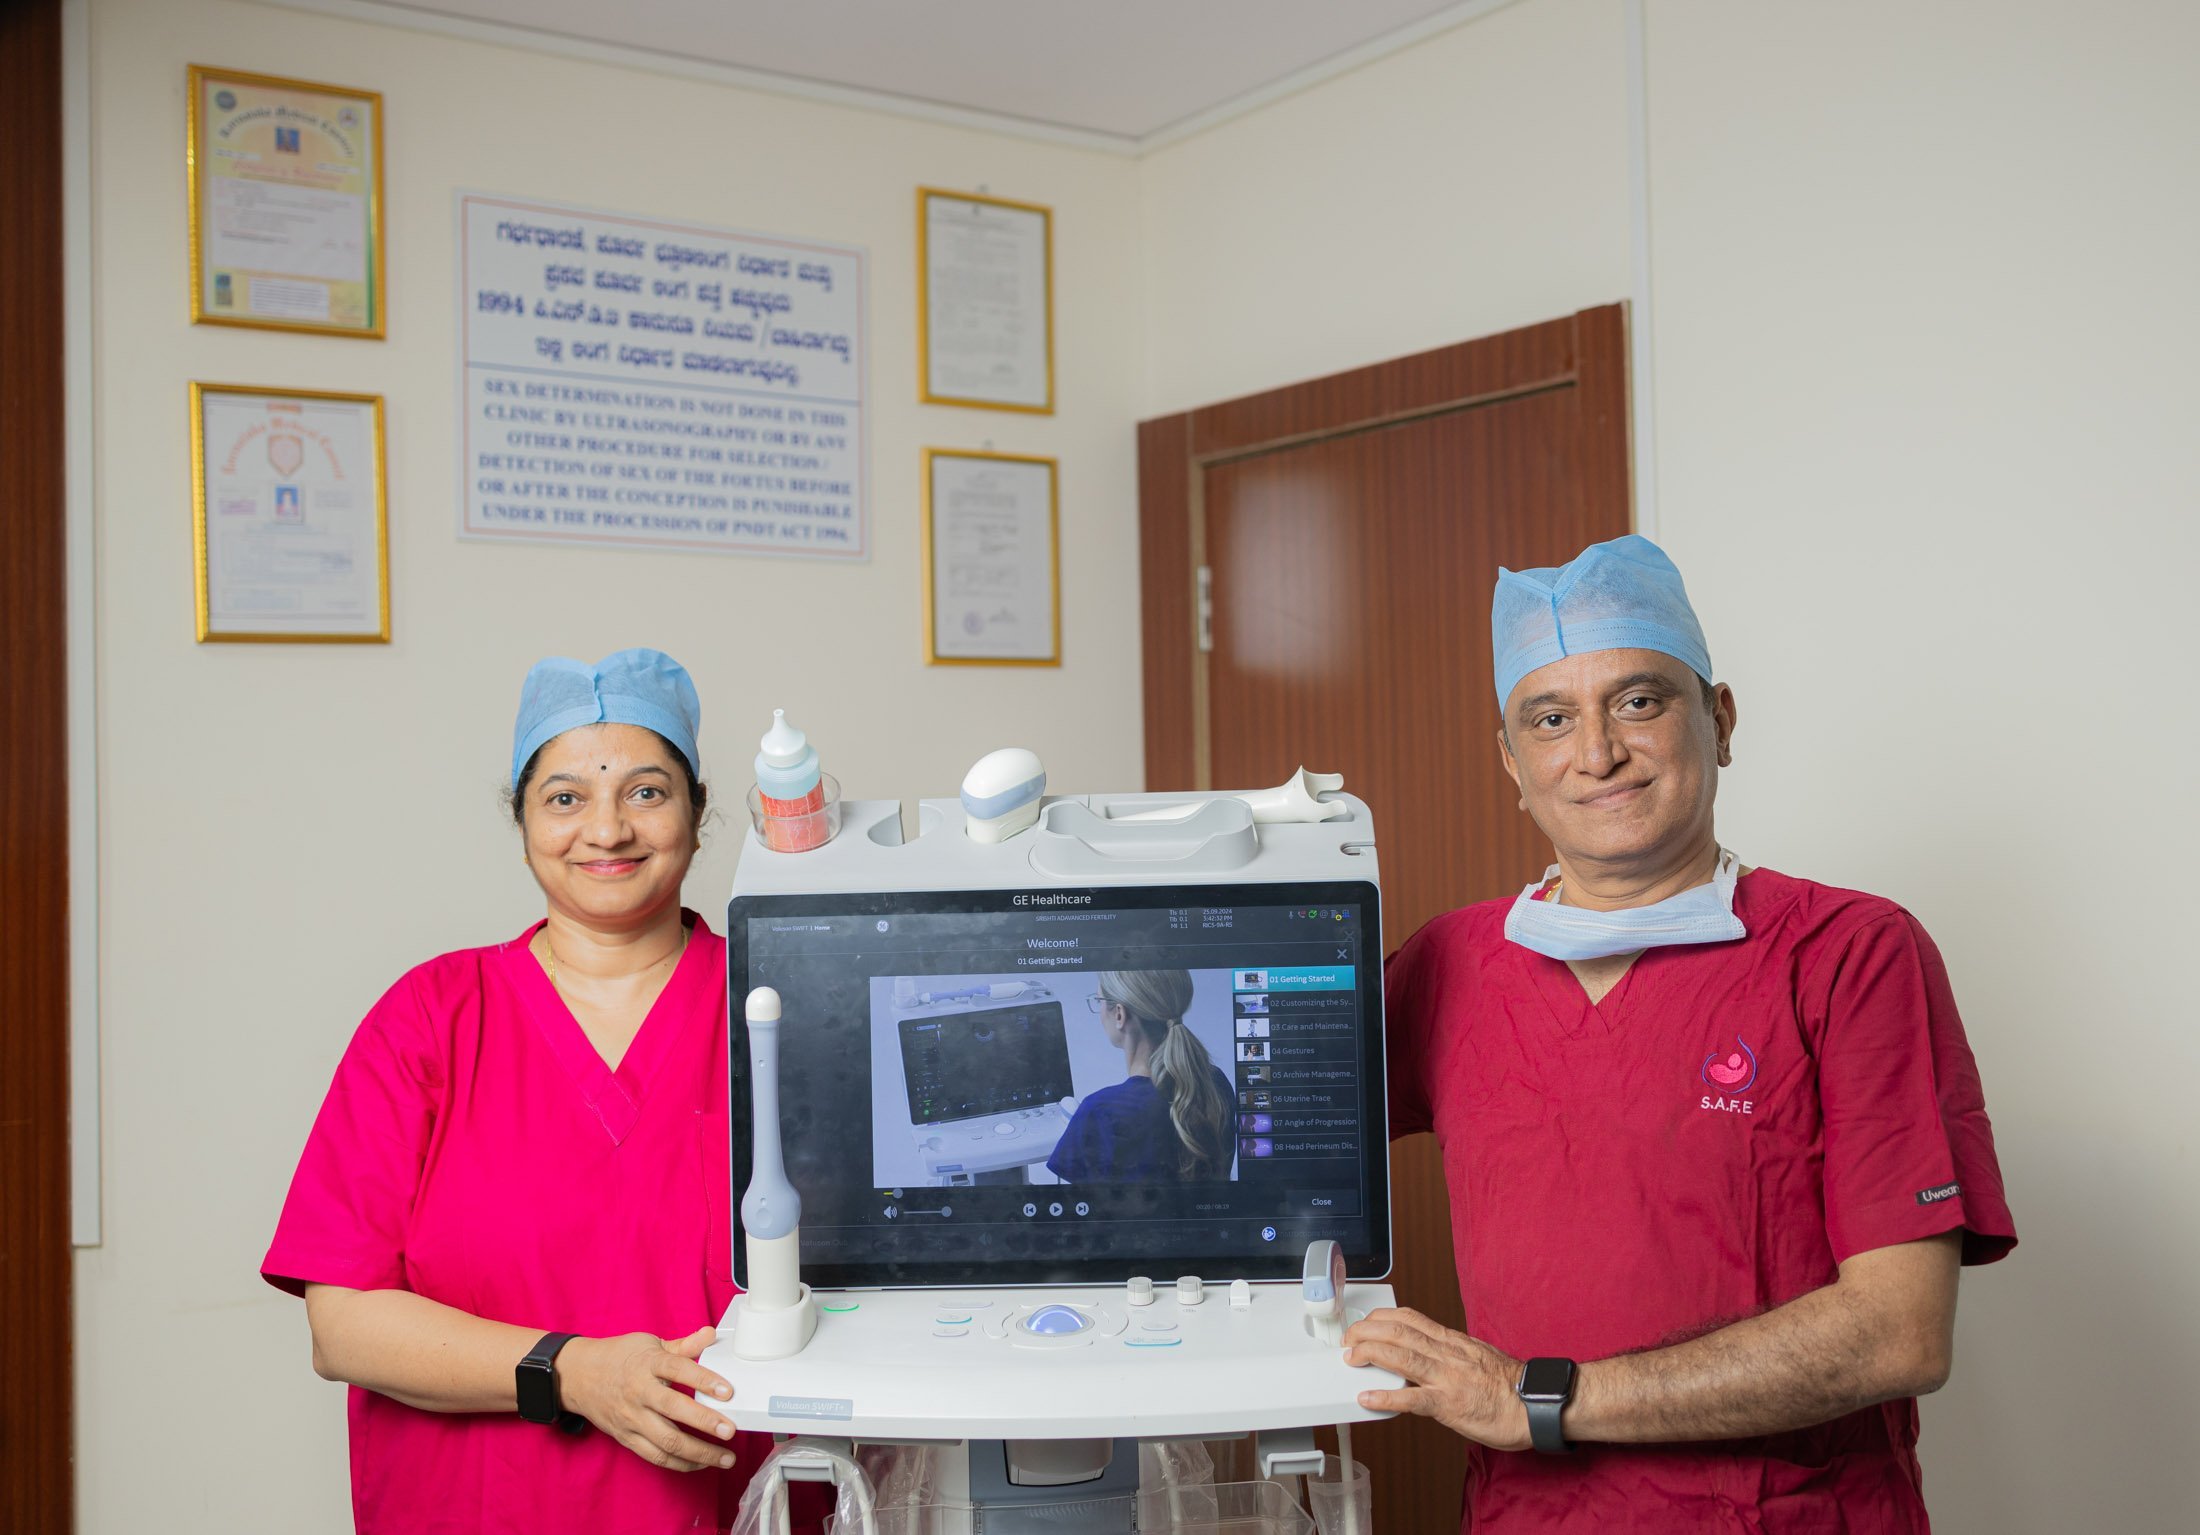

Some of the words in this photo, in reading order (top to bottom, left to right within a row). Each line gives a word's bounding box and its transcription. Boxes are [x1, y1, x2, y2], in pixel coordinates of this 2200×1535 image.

[478, 289, 523, 315] 1994
[700, 400, 733, 415] NOT
[555, 411, 575, 426] BY
[507, 431, 570, 449] OTHER
[689, 446, 720, 461] FOR
[478, 479, 503, 494] OR
[513, 481, 568, 498] AFTER
[576, 486, 608, 501] THE
[482, 504, 545, 521] UNDER
[553, 509, 585, 523] THE
[1012, 895, 1029, 906] GE
[1031, 894, 1091, 905] Healthcare
[1027, 938, 1079, 948] Welcome!
[1028, 957, 1055, 965] Getting
[1056, 956, 1083, 964] Started
[1280, 975, 1307, 984] Getting
[1308, 974, 1335, 982] Started
[1281, 999, 1325, 1008] Customizing
[1327, 998, 1339, 1006] the
[1282, 1047, 1315, 1055] Gestures
[1283, 1071, 1310, 1079] Archive
[1284, 1095, 1311, 1103] Uterine
[1312, 1094, 1331, 1102] Trace
[1700, 1095, 1753, 1115] S.A.F.E
[1273, 1119, 1283, 1127] 07
[1284, 1119, 1305, 1128] Angle
[1315, 1118, 1357, 1127] Progression
[1274, 1143, 1284, 1151] 08
[1305, 1142, 1340, 1150] Perineum
[1311, 1198, 1332, 1206] Close
